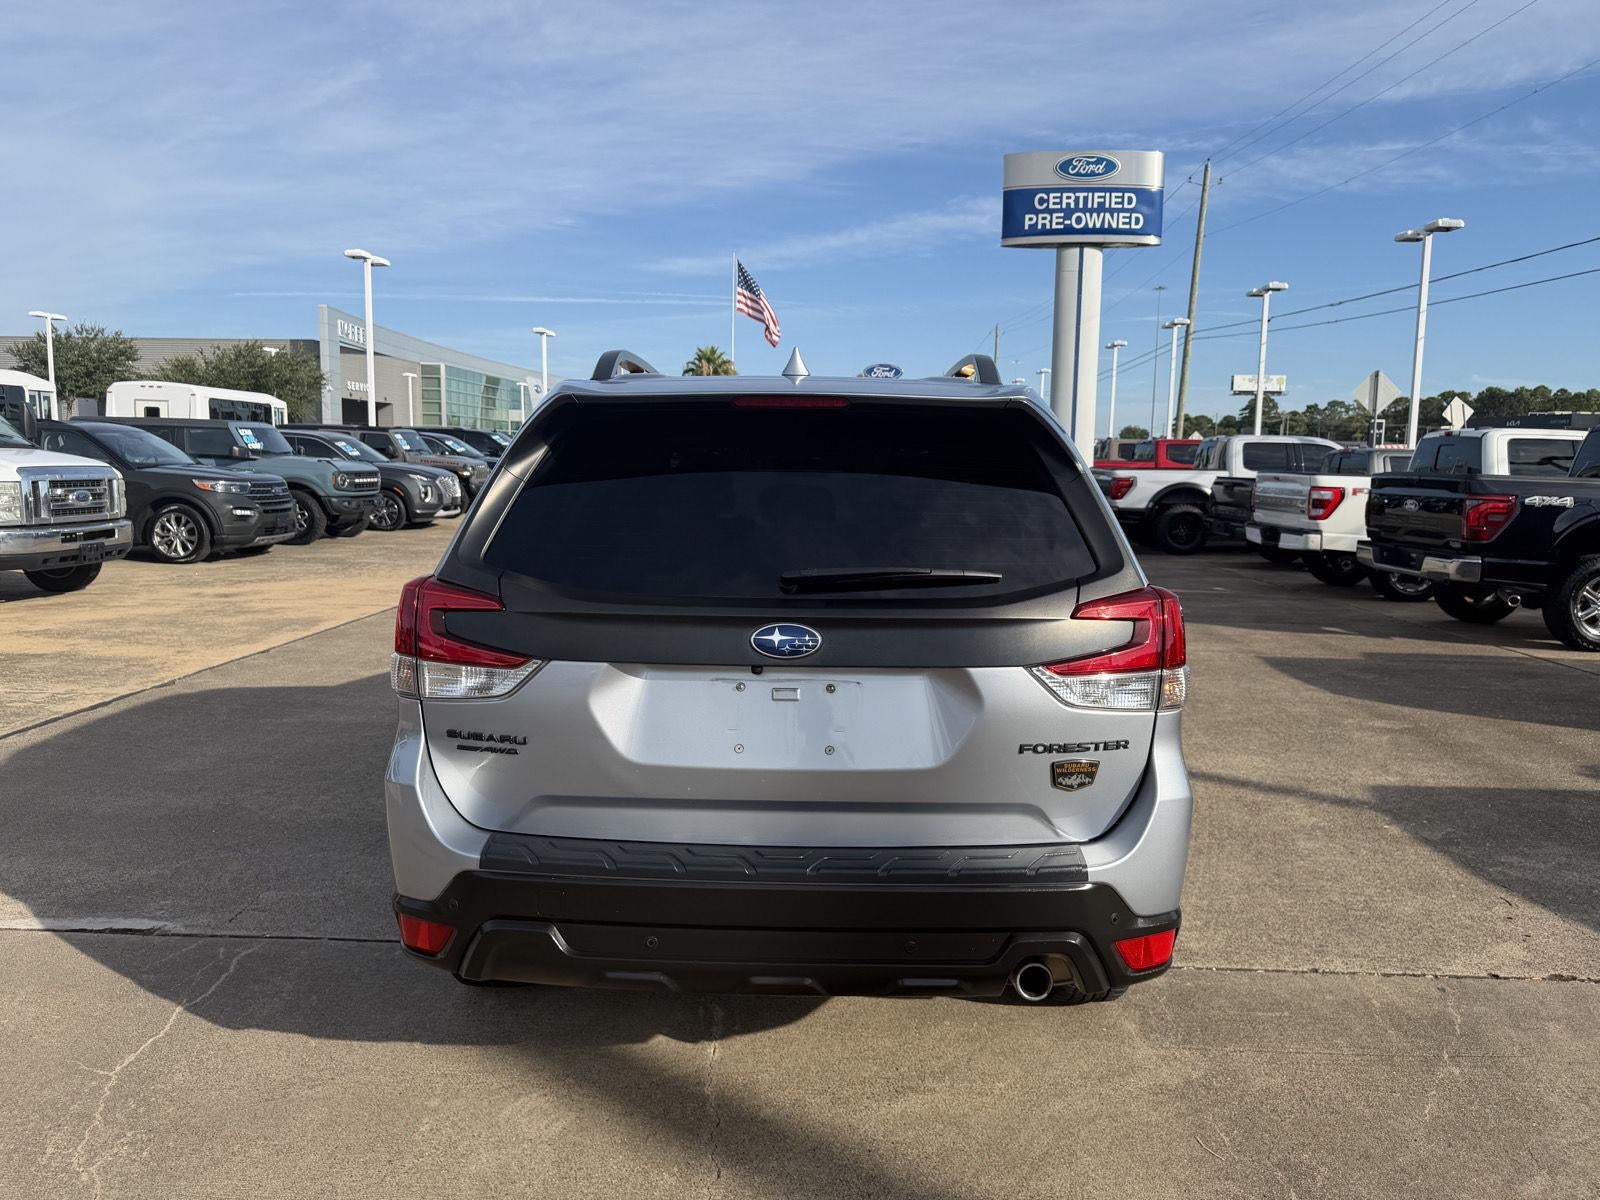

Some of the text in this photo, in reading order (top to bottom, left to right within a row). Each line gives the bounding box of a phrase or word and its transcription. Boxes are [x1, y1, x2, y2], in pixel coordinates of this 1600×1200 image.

[1069, 157, 1106, 174] Ford
[1034, 192, 1137, 210] CERTIFIED
[1024, 212, 1144, 230] PRE-OWNED
[446, 729, 528, 745] SUBARU
[1018, 740, 1130, 754] FORESTER
